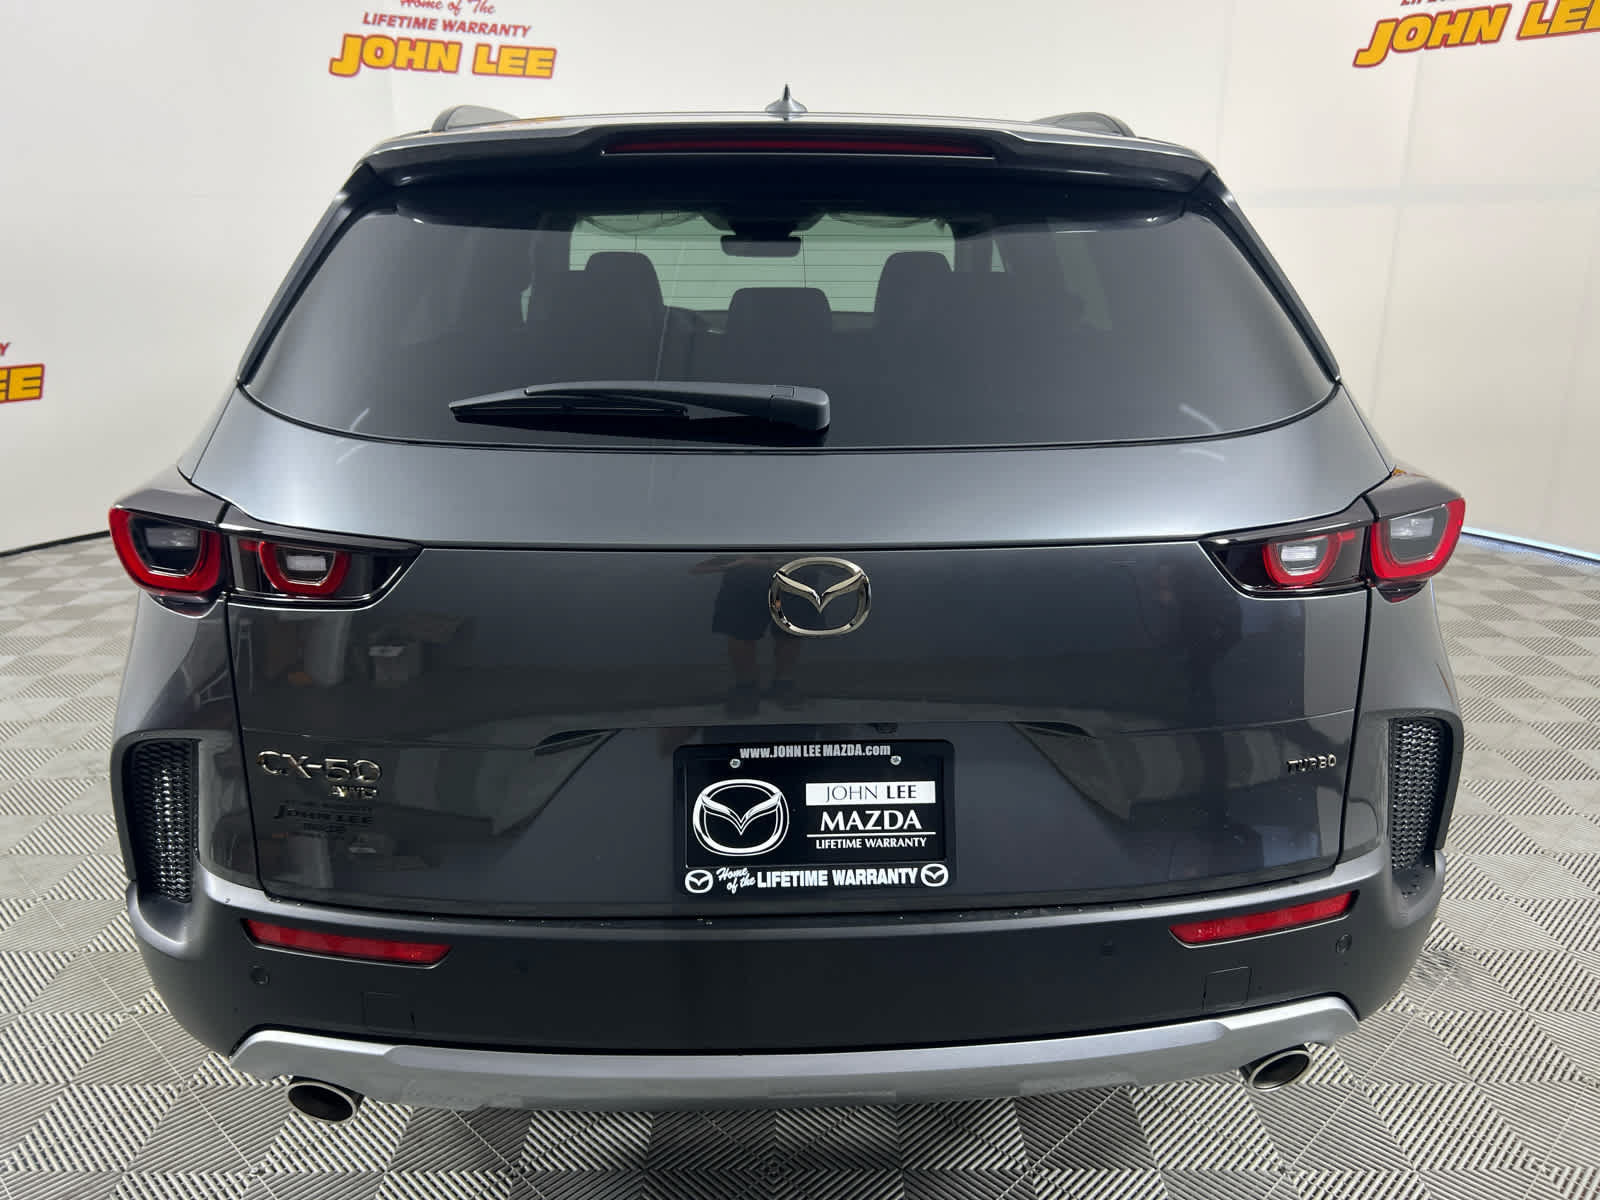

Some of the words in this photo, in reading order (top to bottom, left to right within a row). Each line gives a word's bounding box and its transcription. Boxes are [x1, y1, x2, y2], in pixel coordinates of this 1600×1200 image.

[447, 0, 461, 16] of
[362, 12, 438, 31] LIFETIME
[442, 17, 532, 38] WARRANTY
[1352, 3, 1512, 68] JOHN
[329, 33, 463, 77] JOHN
[472, 43, 557, 79] LEE
[256, 750, 382, 784] CX-50
[1287, 754, 1336, 772] TURBO
[825, 785, 878, 803] JOHN
[886, 784, 918, 800] LEE
[820, 809, 923, 832] MAZDA
[816, 838, 862, 850] LIFETIME
[865, 836, 927, 849] WARRANTY
[716, 867, 748, 881] Home
[726, 878, 739, 894] of
[740, 873, 756, 888] the
[757, 870, 828, 889] LIFETIME
[832, 867, 918, 887] WARRANTY
